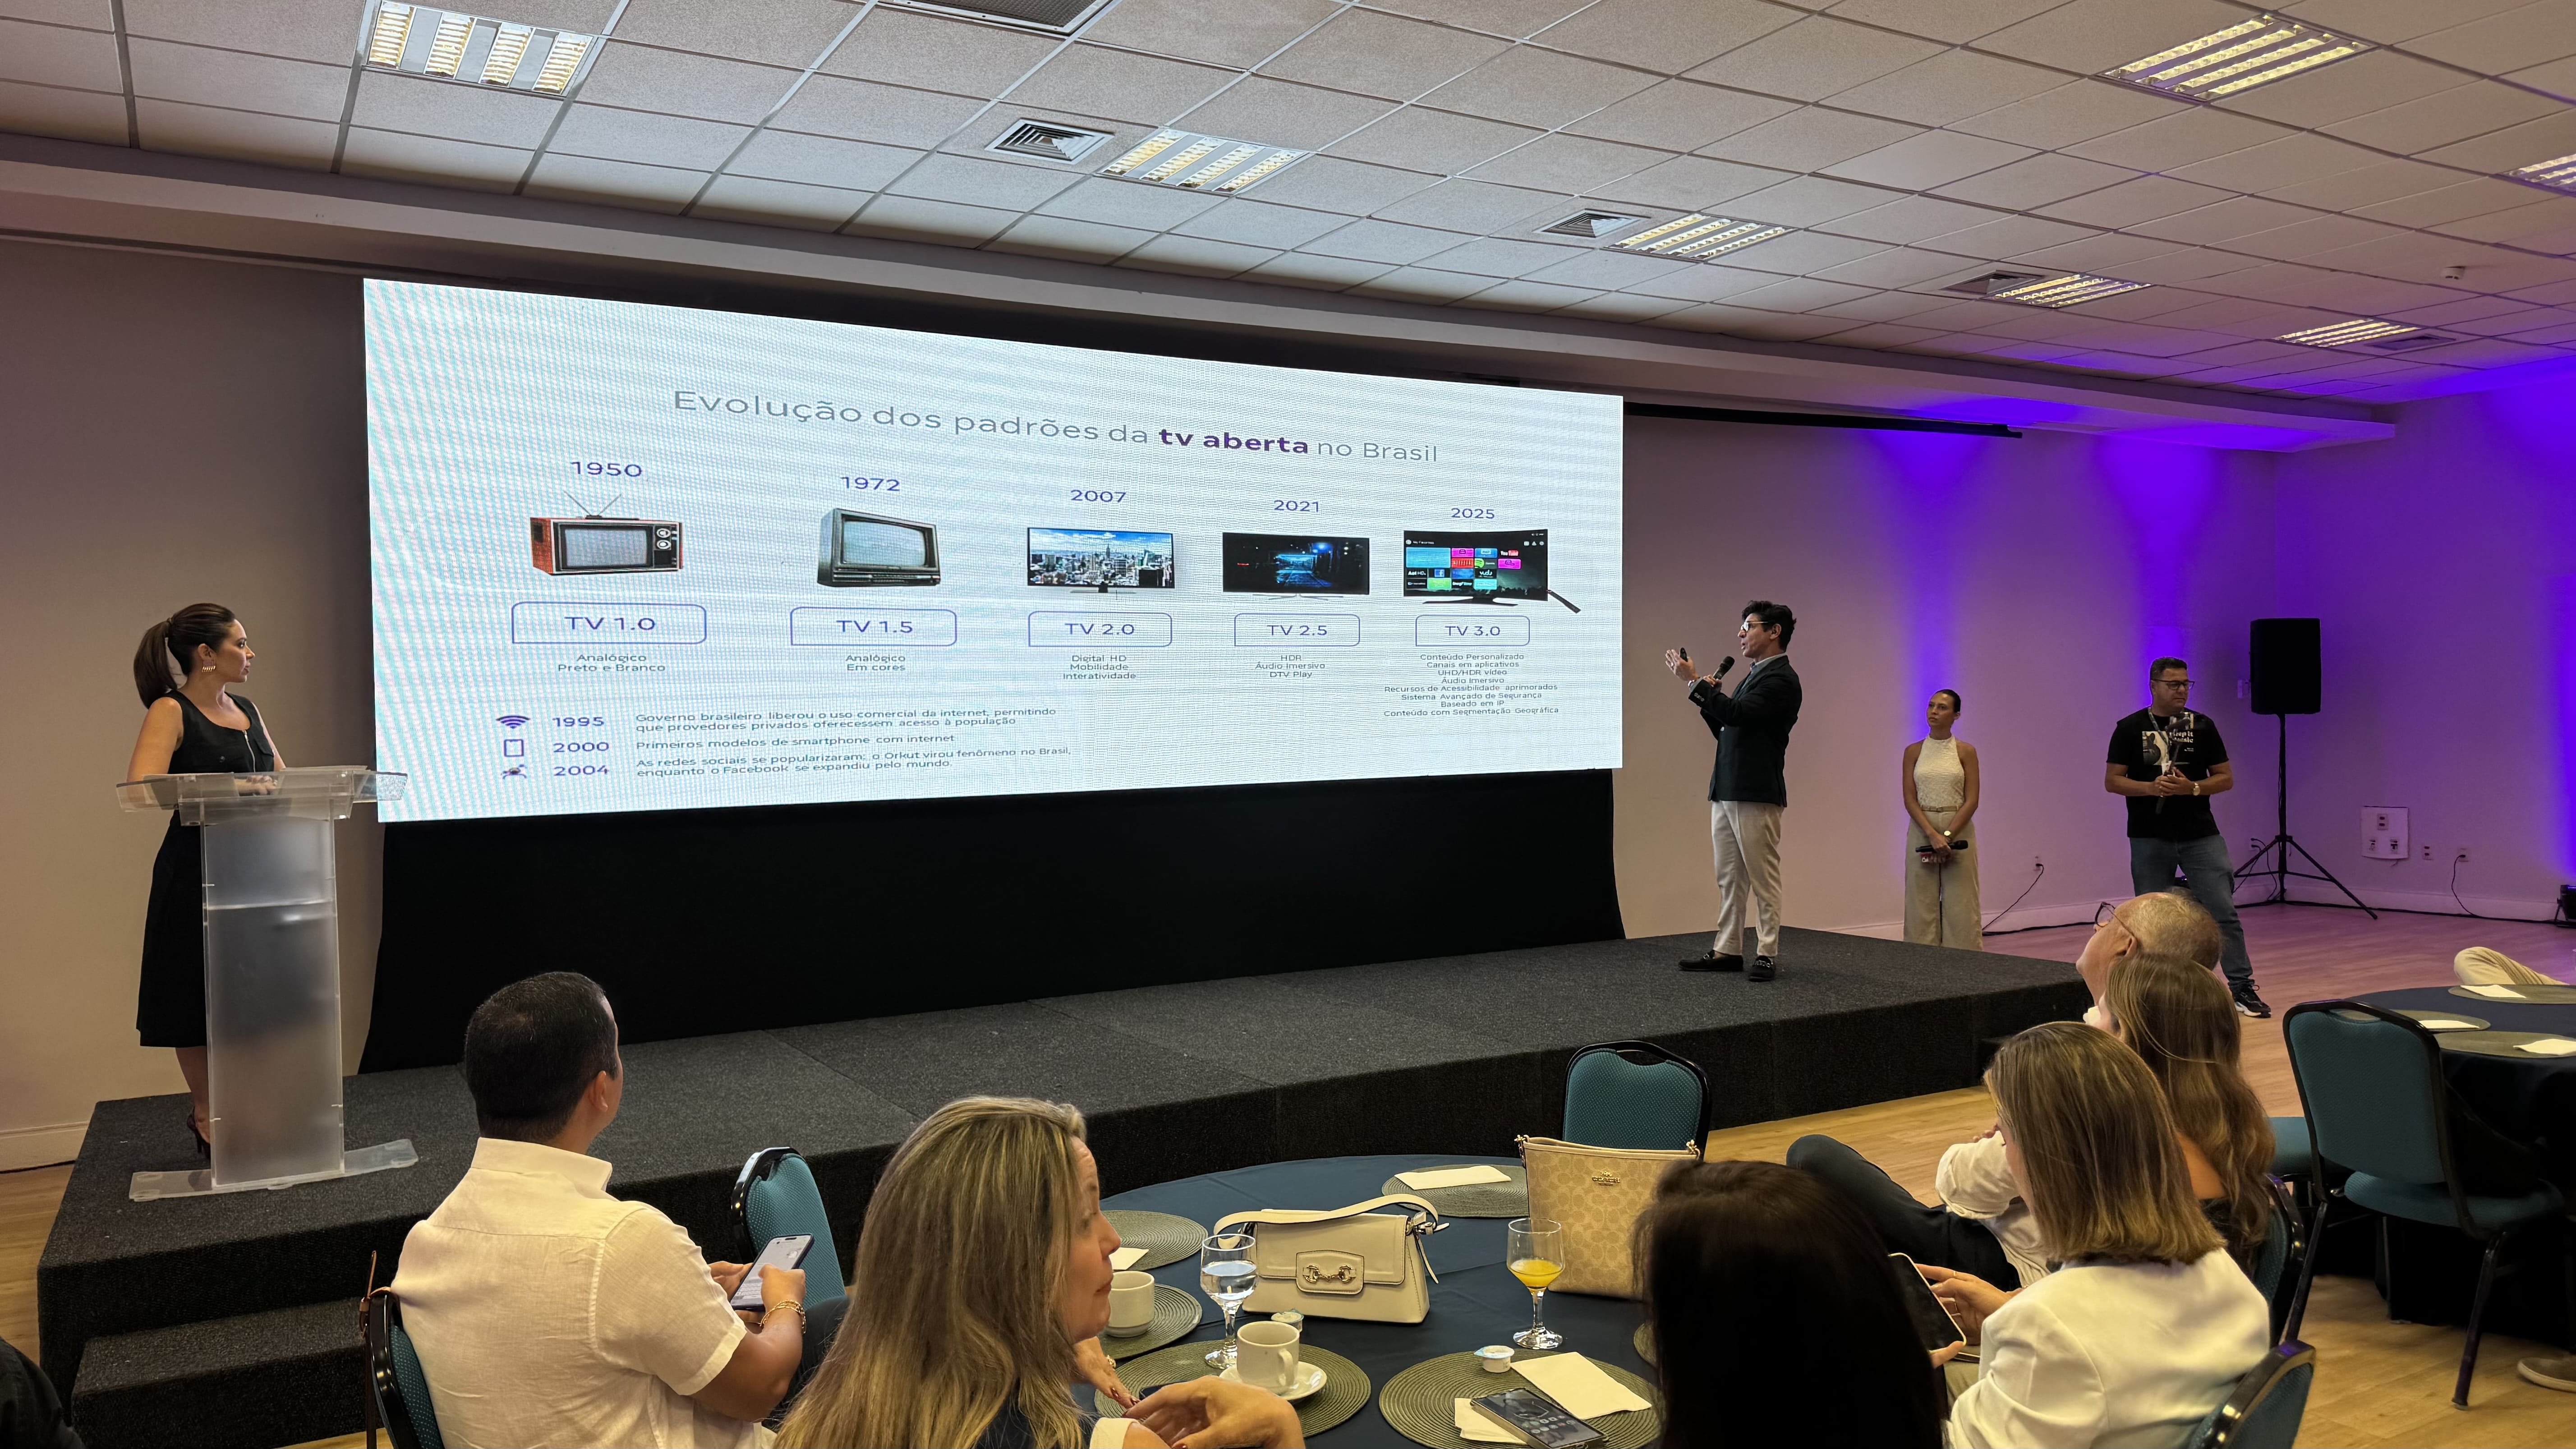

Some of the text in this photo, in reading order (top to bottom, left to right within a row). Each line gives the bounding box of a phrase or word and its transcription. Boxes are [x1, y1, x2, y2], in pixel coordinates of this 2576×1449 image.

[674, 391, 1437, 462] Evolução dos padrões da tv aberta no Brasil
[570, 461, 642, 477] 1950
[841, 477, 900, 492] 1972
[1070, 490, 1126, 503] 2007
[1274, 500, 1319, 513] 2021
[1451, 508, 1495, 519] 2025
[565, 617, 655, 630] TV 1.0
[836, 620, 913, 633] TV 1.5
[1065, 623, 1135, 635] TV 2.0
[1267, 625, 1328, 636] TV 2.5
[1445, 626, 1500, 636] TV 3.0
[577, 654, 647, 663] Analógico
[845, 654, 906, 663] Analógico
[1072, 655, 1104, 663] Digital
[1255, 661, 1283, 669] Áudio
[701, 713, 762, 721] brasileiro
[857, 710, 916, 718] comercial
[994, 708, 1056, 717] permitindo
[552, 716, 604, 727] 1995
[636, 724, 663, 733] que
[668, 722, 746, 732] provedores
[751, 722, 808, 731] privados
[956, 717, 1016, 727] população
[553, 742, 609, 753] 2000
[637, 741, 703, 750] Primeiros
[708, 739, 766, 747] modelos
[793, 737, 870, 746] smartphone
[702, 756, 747, 765] sociais
[554, 765, 609, 776] 2004
[637, 768, 704, 777] enquanto
[724, 765, 789, 773] Facebook
[813, 763, 869, 772] expandiu
[875, 761, 901, 770] pelo
